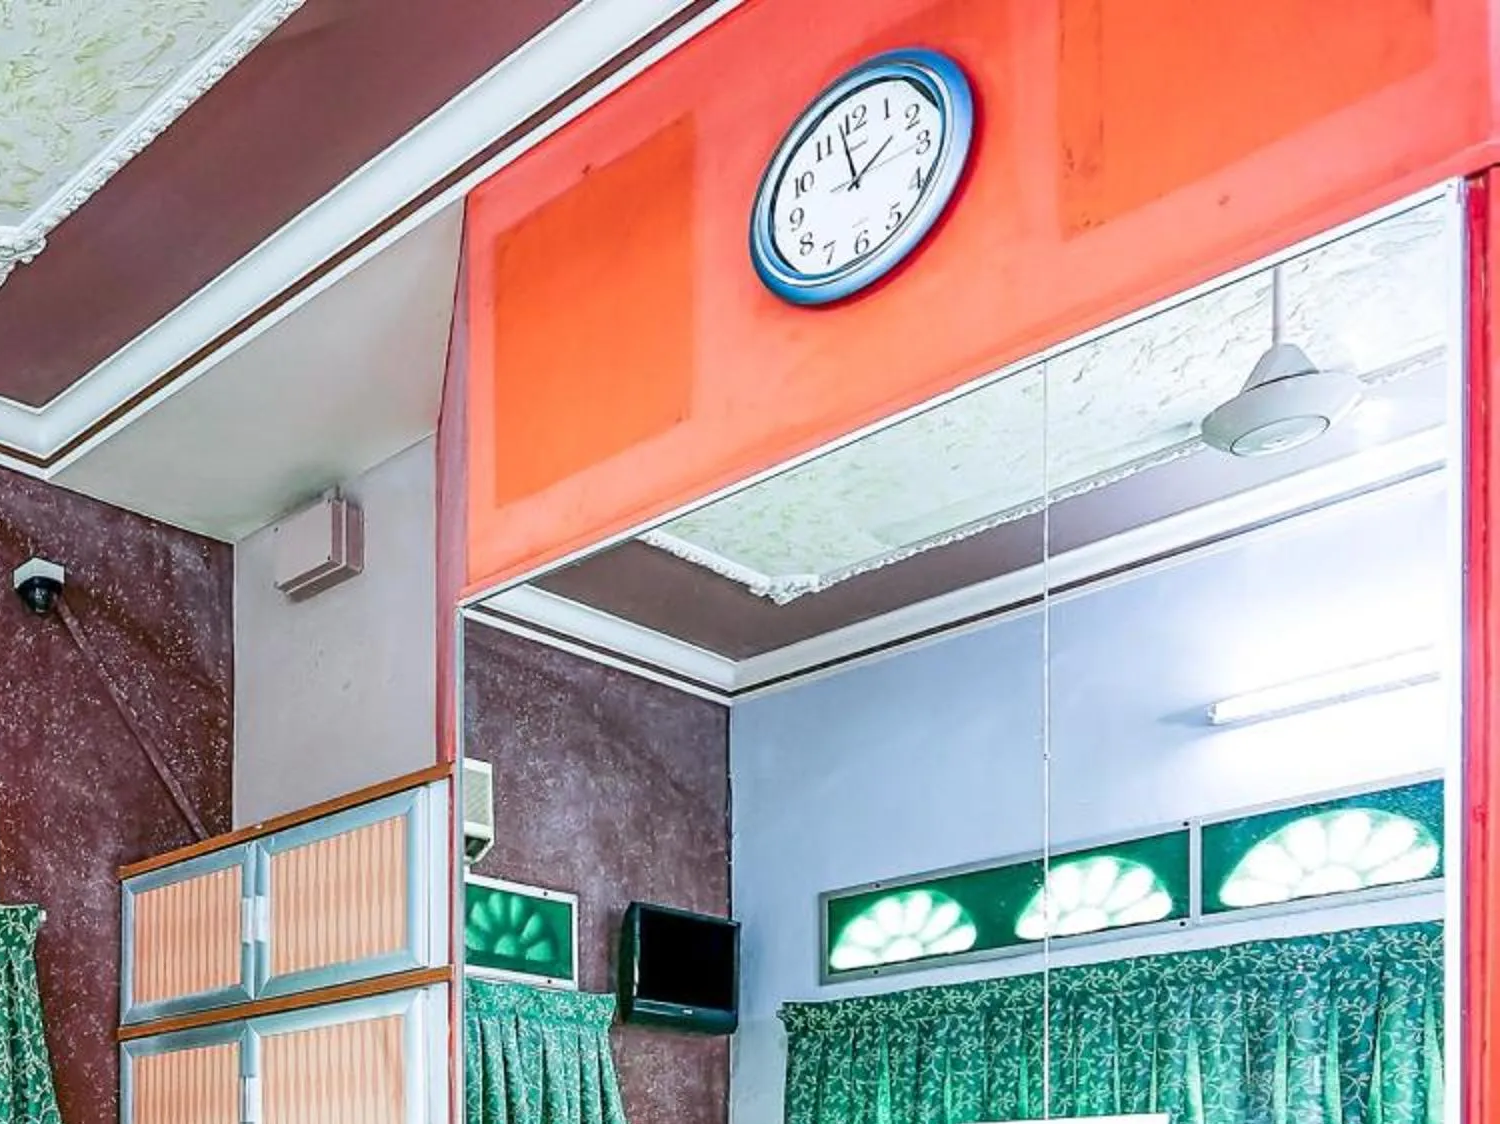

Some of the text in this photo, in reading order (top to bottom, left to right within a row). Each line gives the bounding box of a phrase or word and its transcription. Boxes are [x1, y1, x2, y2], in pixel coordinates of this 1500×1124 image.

[845, 104, 869, 135] 12
[883, 96, 892, 120] 1
[904, 103, 921, 131] 2
[815, 134, 833, 163] 11
[915, 130, 931, 155] 3
[794, 171, 815, 200] 10
[908, 166, 924, 192] 4
[789, 207, 805, 232] 9
[885, 202, 902, 231] 5
[799, 232, 814, 256] 8
[822, 240, 836, 266] 7
[854, 229, 869, 253] 6
